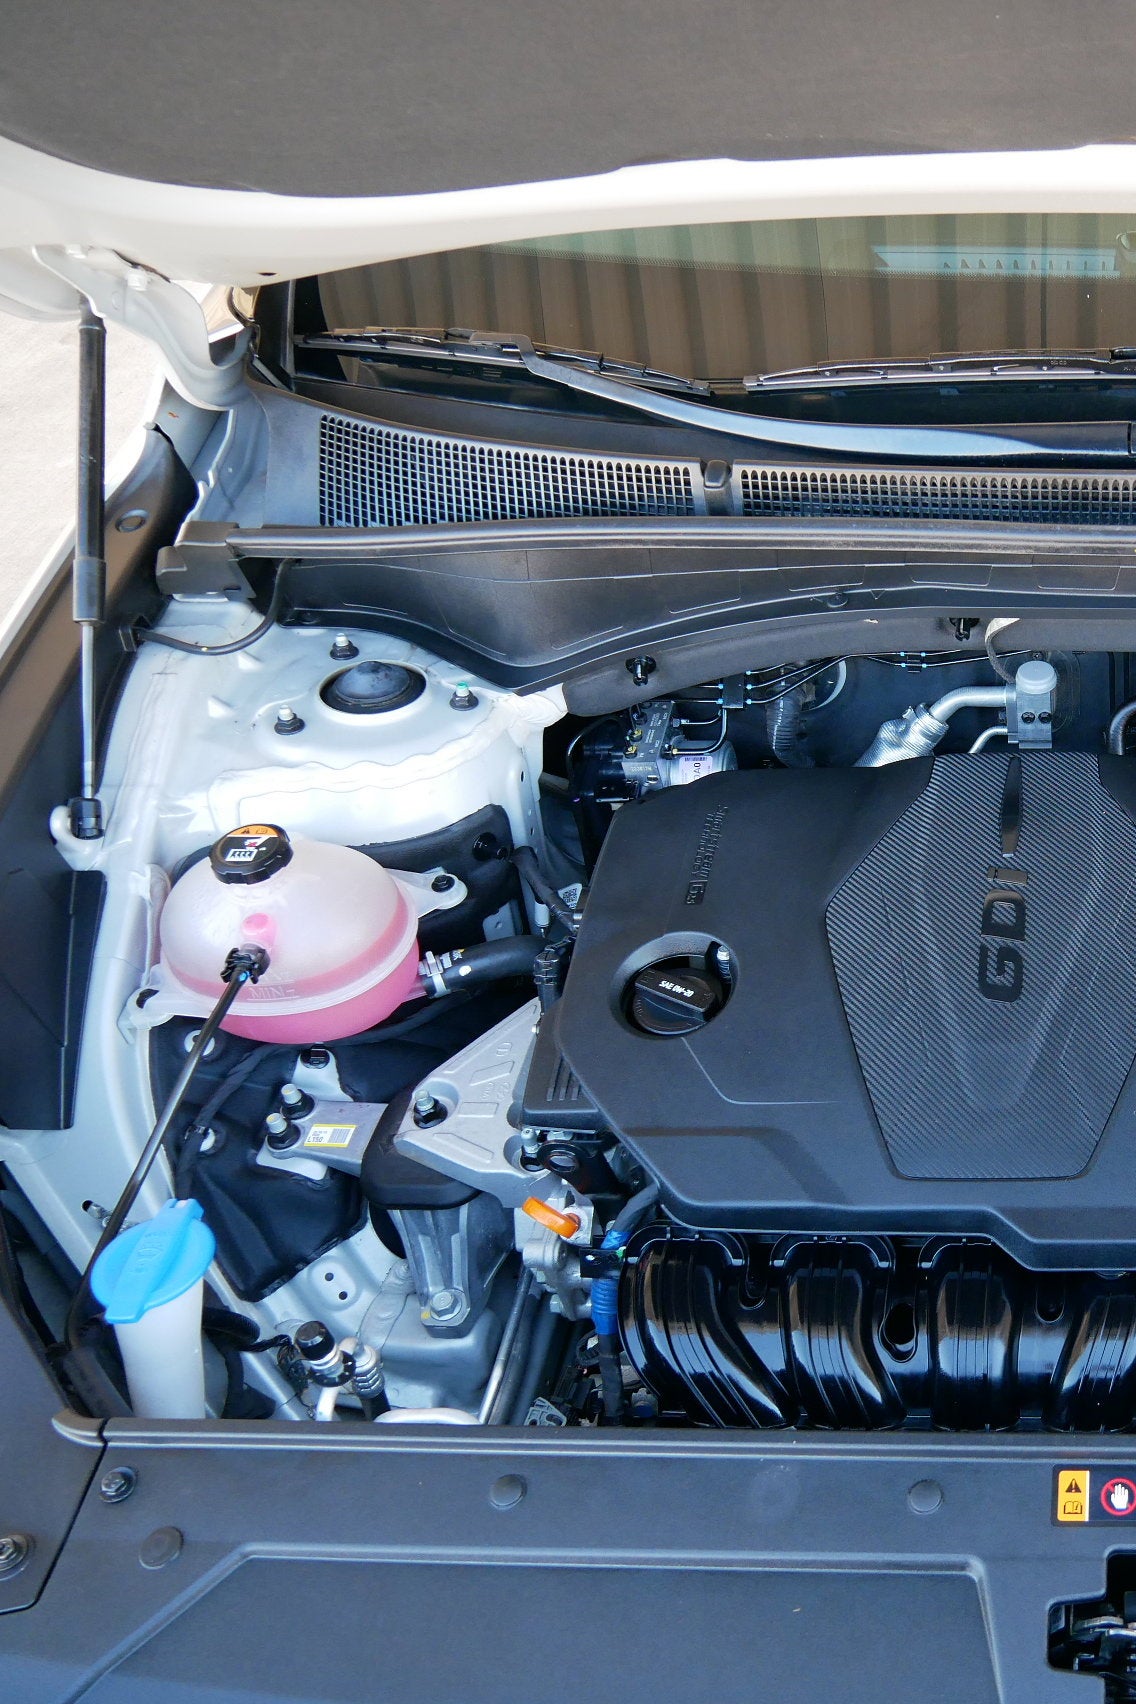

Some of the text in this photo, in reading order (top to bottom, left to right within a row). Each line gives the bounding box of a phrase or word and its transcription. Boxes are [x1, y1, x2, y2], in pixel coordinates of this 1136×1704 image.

[978, 866, 1029, 1003] GDi
[659, 981, 694, 997] SAE 0W-20
